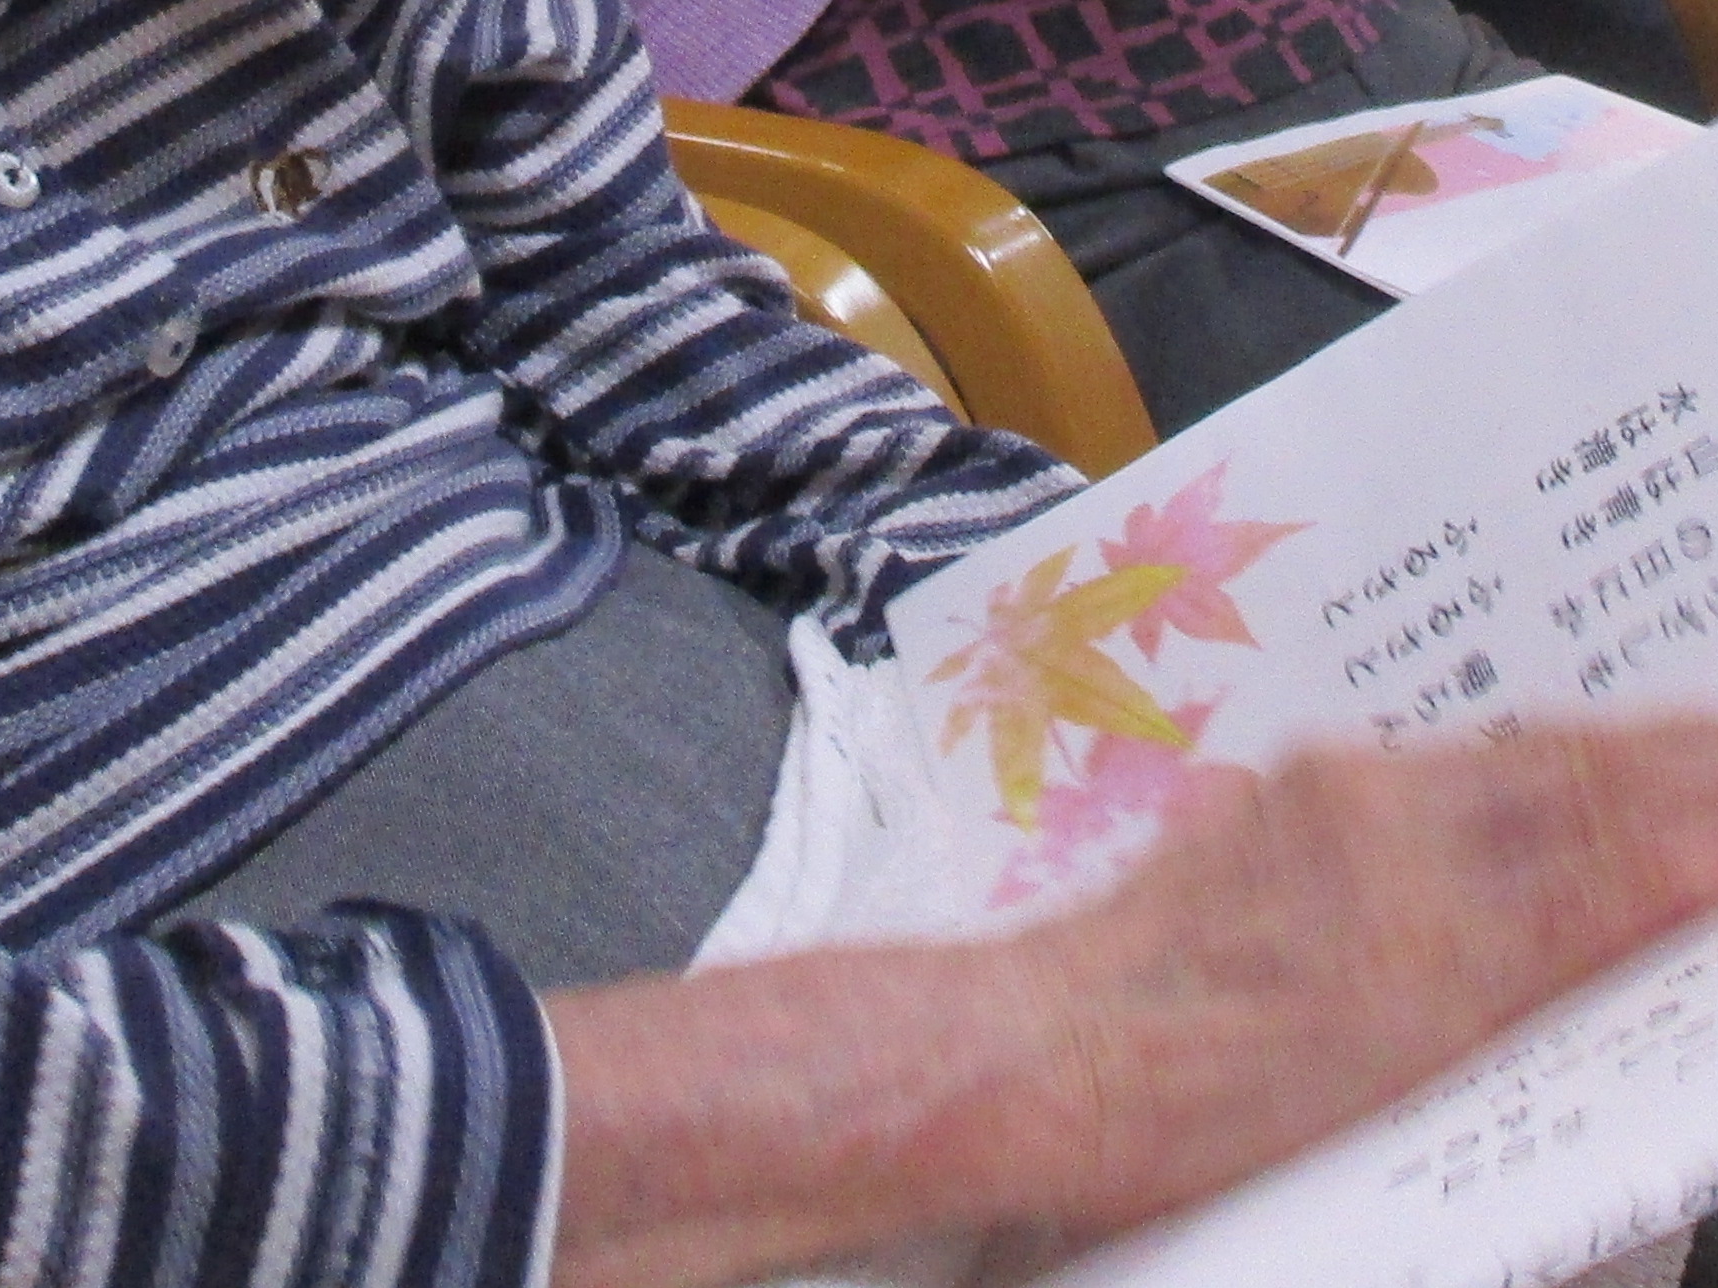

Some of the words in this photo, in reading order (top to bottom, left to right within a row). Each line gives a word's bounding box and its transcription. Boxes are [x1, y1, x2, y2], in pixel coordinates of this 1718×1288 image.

[1535, 382, 1699, 492] 水は清き
[1322, 518, 1480, 628] ふるさと
[1346, 575, 1505, 686] ふるさと
